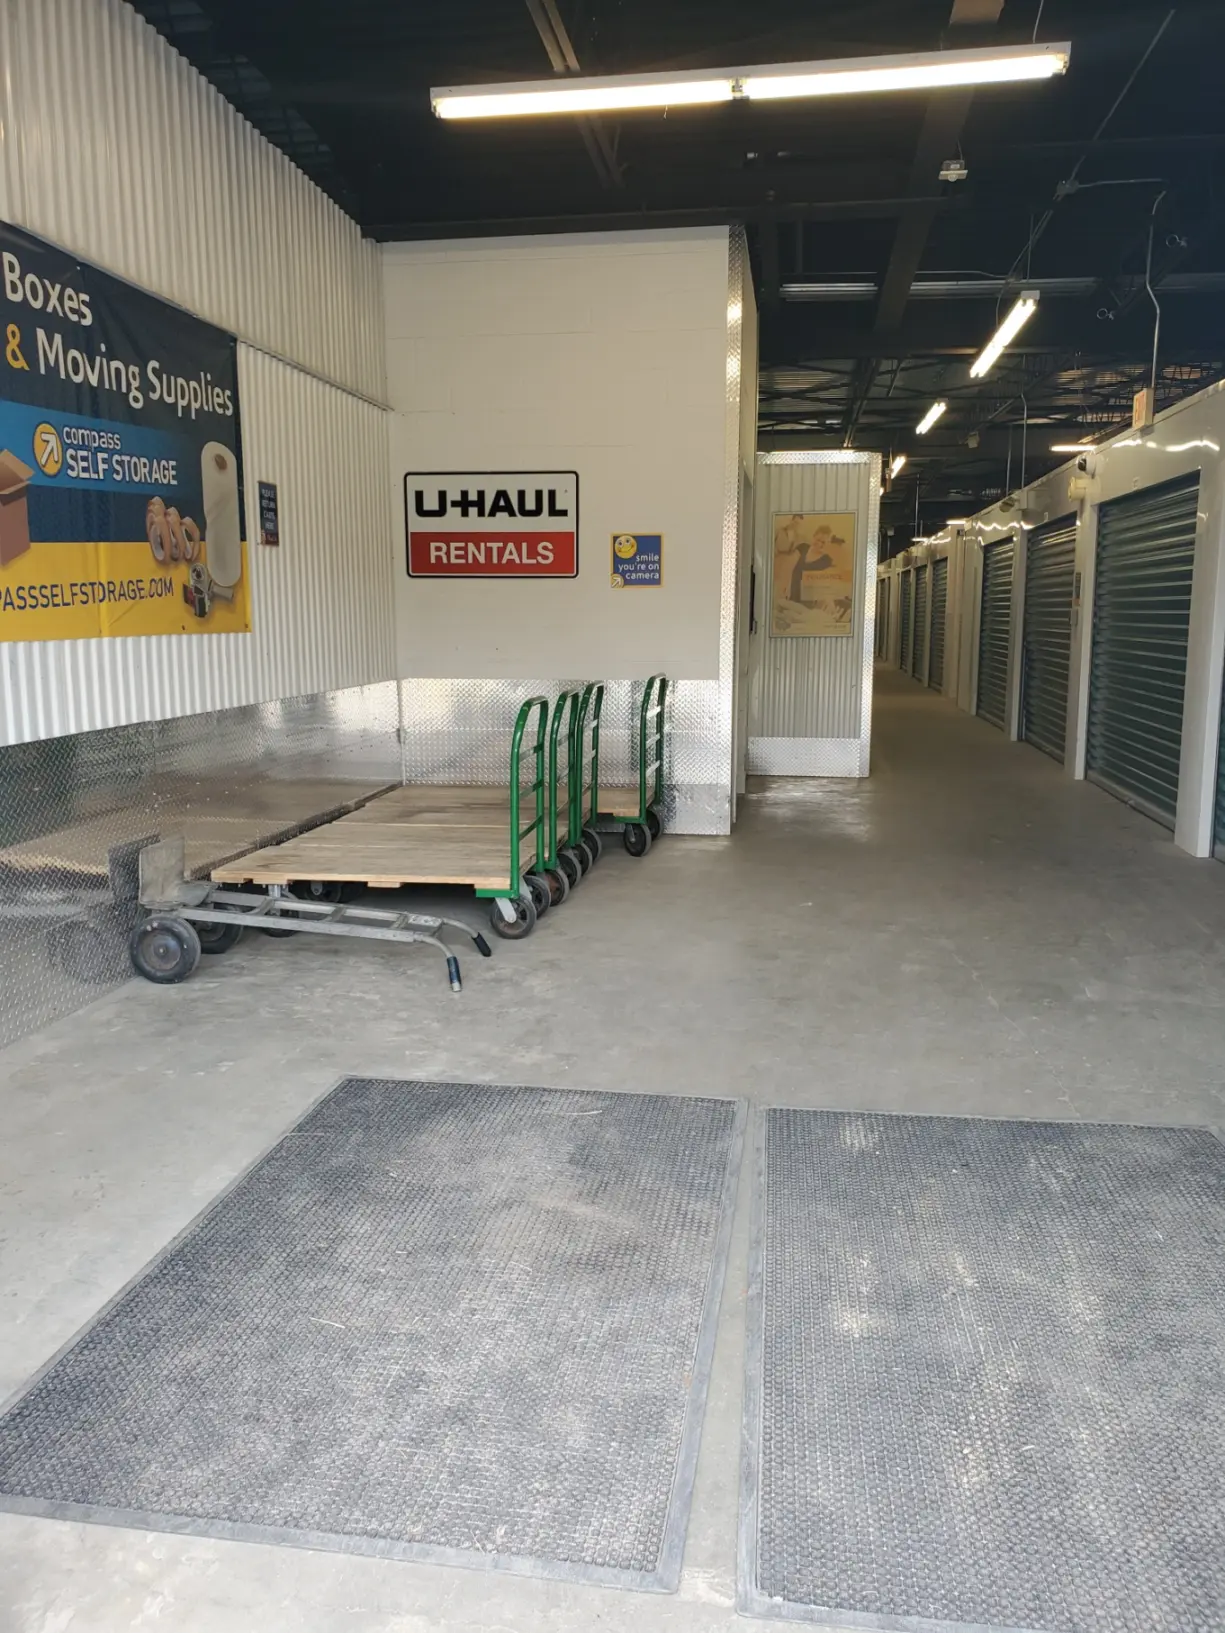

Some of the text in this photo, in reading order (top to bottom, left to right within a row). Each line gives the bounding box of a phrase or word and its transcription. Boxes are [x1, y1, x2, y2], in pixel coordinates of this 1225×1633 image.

[3, 251, 93, 326] Boxes
[6, 323, 233, 420] & Moving Supplies
[63, 426, 121, 450] compass
[66, 449, 178, 485] SELF STORAGE
[414, 489, 568, 517] U-HAUL
[429, 541, 554, 564] RENTALS
[635, 552, 660, 562] smile
[618, 562, 647, 573] you're
[625, 572, 660, 580] camera
[0, 576, 174, 611] ASSSELFSTORAGE.COM
